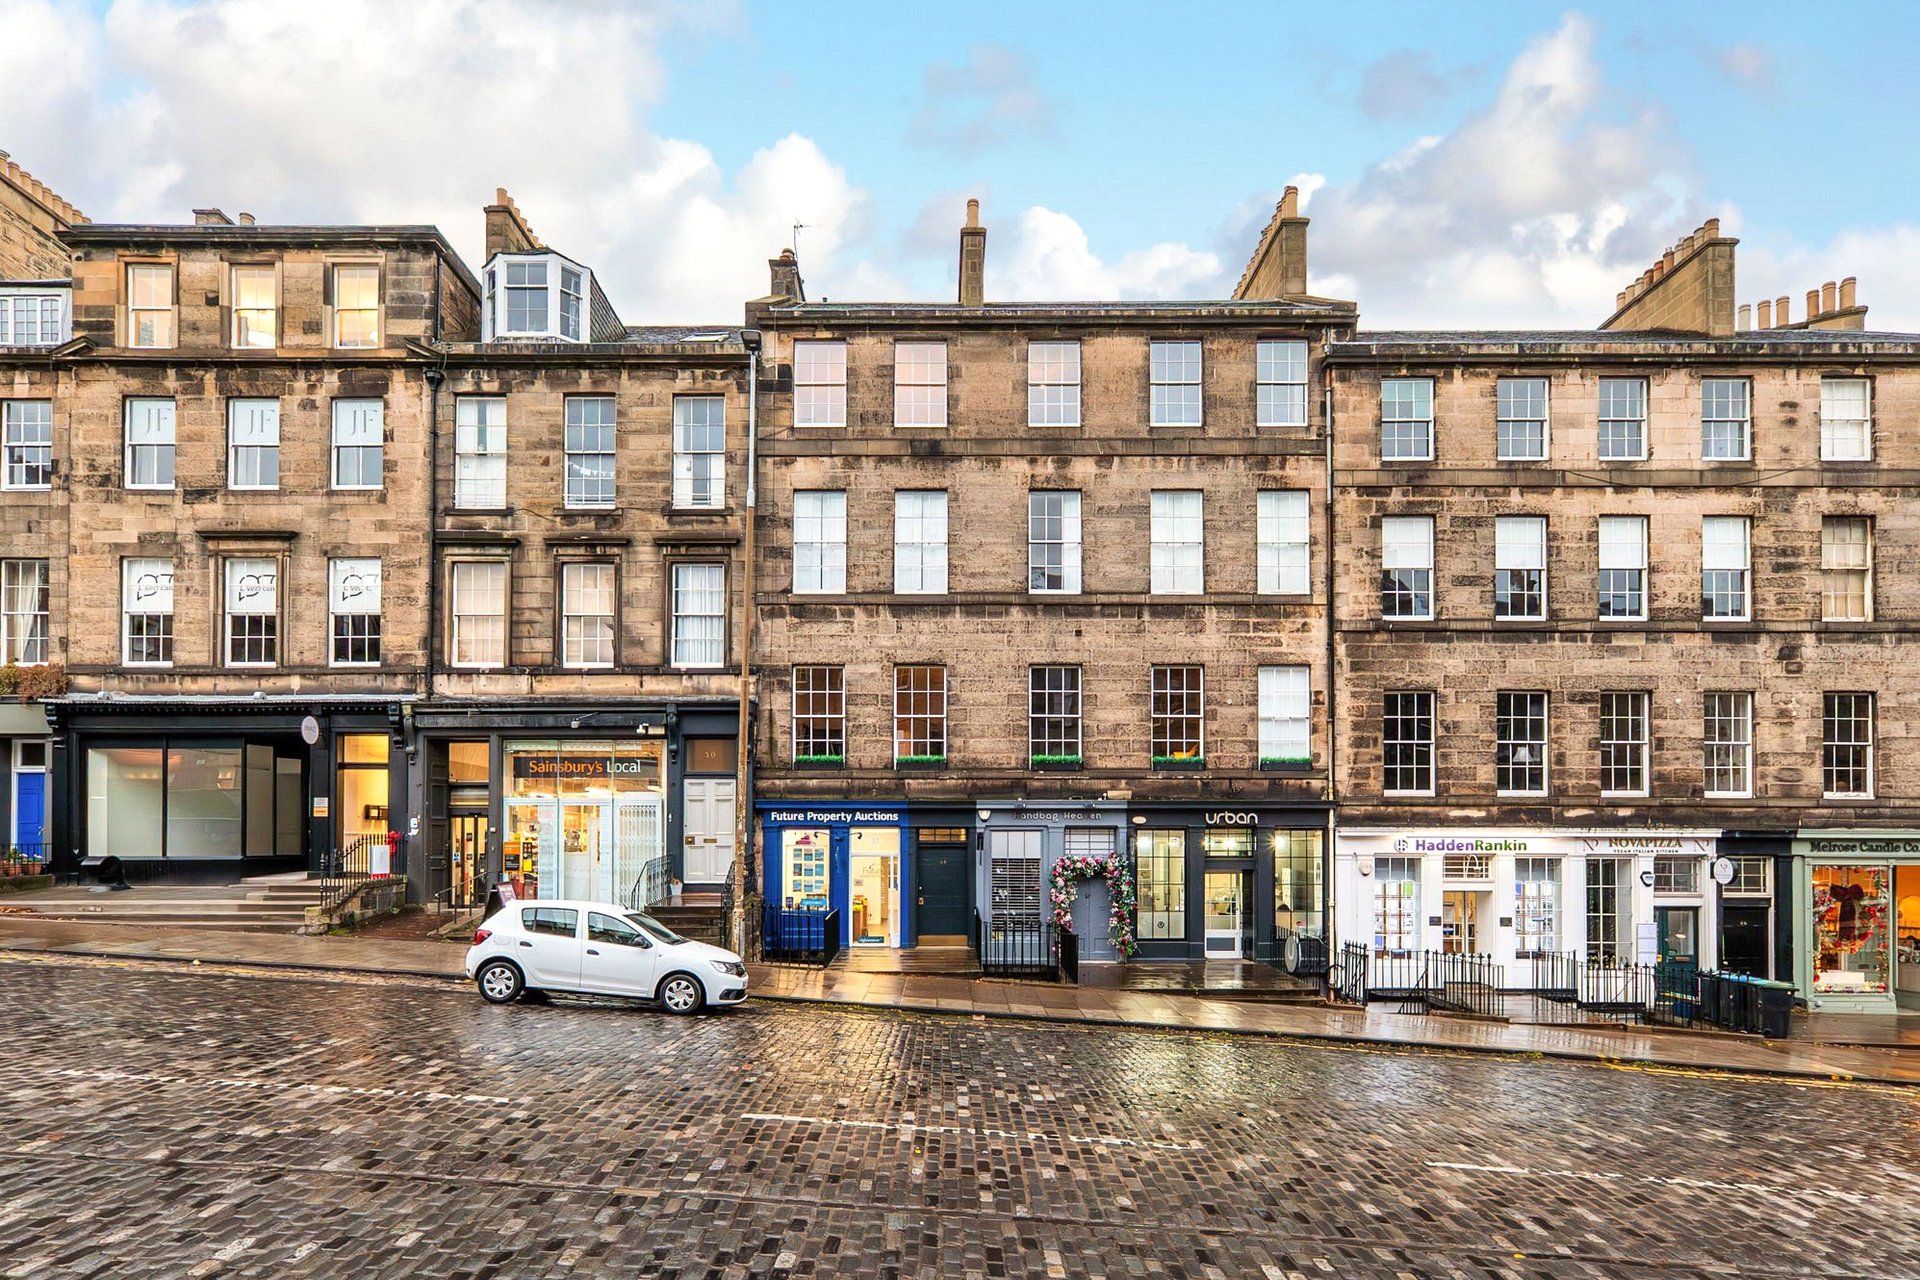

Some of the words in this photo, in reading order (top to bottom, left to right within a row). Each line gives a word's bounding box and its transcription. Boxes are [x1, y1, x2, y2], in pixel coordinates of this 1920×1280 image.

[529, 760, 603, 775] Sainsbury's
[607, 759, 641, 773] Local
[771, 811, 805, 821] Future
[807, 811, 852, 823] Property
[854, 811, 899, 821] Auctions
[1205, 810, 1258, 824] urban
[1415, 839, 1527, 851] HaddenRankin
[1608, 838, 1683, 848] NOVAPIZZA
[1809, 841, 1858, 853] Melrose
[1860, 841, 1901, 853] Candle
